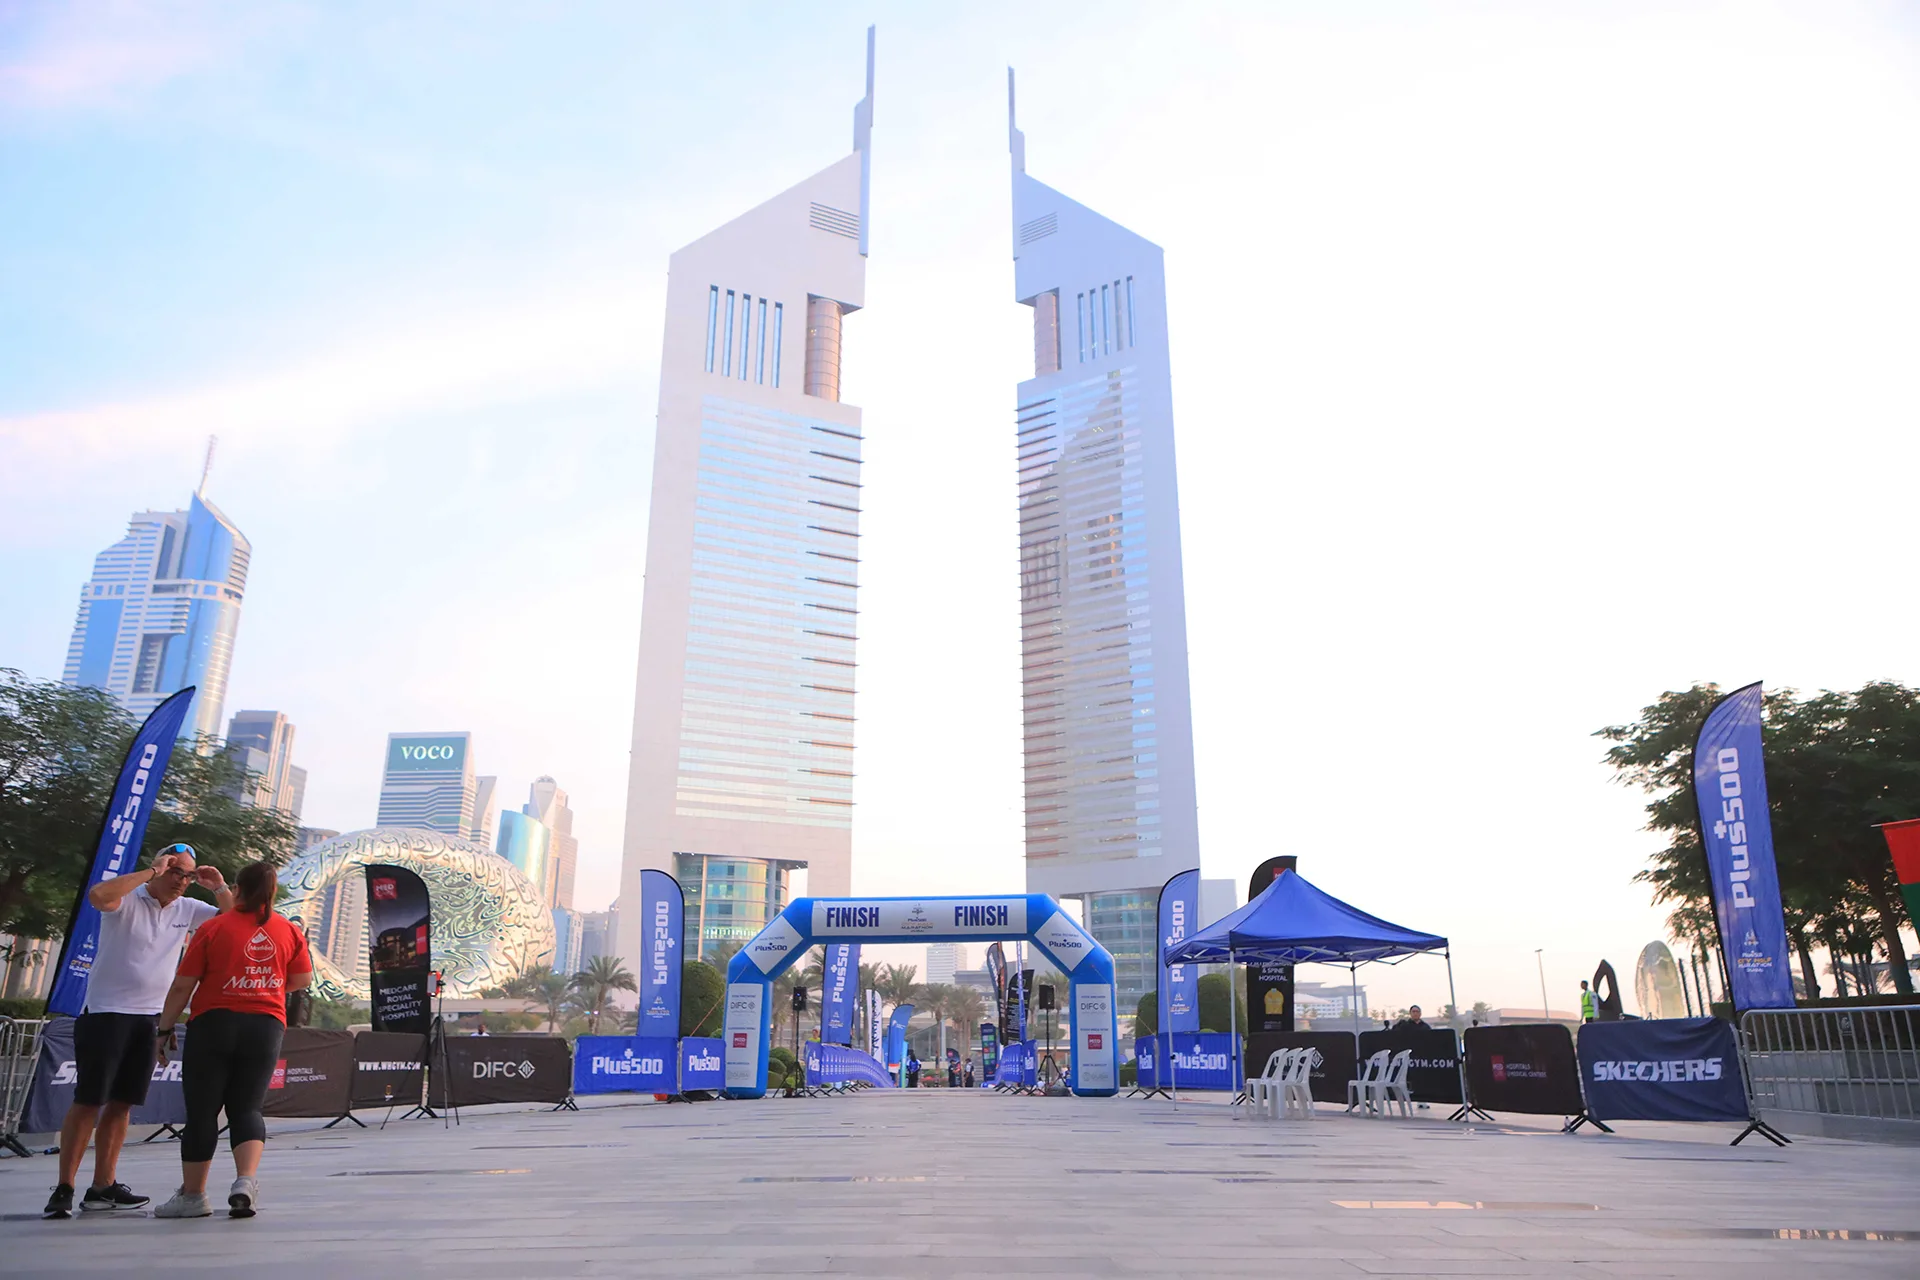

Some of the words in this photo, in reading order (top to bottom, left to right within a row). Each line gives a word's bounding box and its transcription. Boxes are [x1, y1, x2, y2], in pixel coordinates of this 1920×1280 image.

[101, 744, 158, 881] lus500
[1714, 747, 1756, 909] Plus500
[826, 906, 880, 928] FINISH
[954, 905, 1008, 927] FINISH
[754, 943, 788, 952] Plus500
[1048, 939, 1082, 949] Plus500
[245, 966, 272, 975] TEAM
[222, 973, 284, 990] MonViso
[379, 983, 417, 995] MEDCARE
[386, 994, 413, 1003] ROYAL
[731, 1001, 748, 1009] DIFC
[379, 1000, 422, 1012] SPECIALITY
[1080, 1002, 1099, 1010] DIFC
[381, 1010, 420, 1021] HOSPITAL
[592, 1053, 663, 1075] Plus500
[688, 1052, 721, 1072] Plus500
[1171, 1050, 1227, 1070] Plus500
[287, 1067, 314, 1075] HOSPITALS
[473, 1061, 517, 1078] DIFC
[1593, 1057, 1723, 1082] SKECHERS
